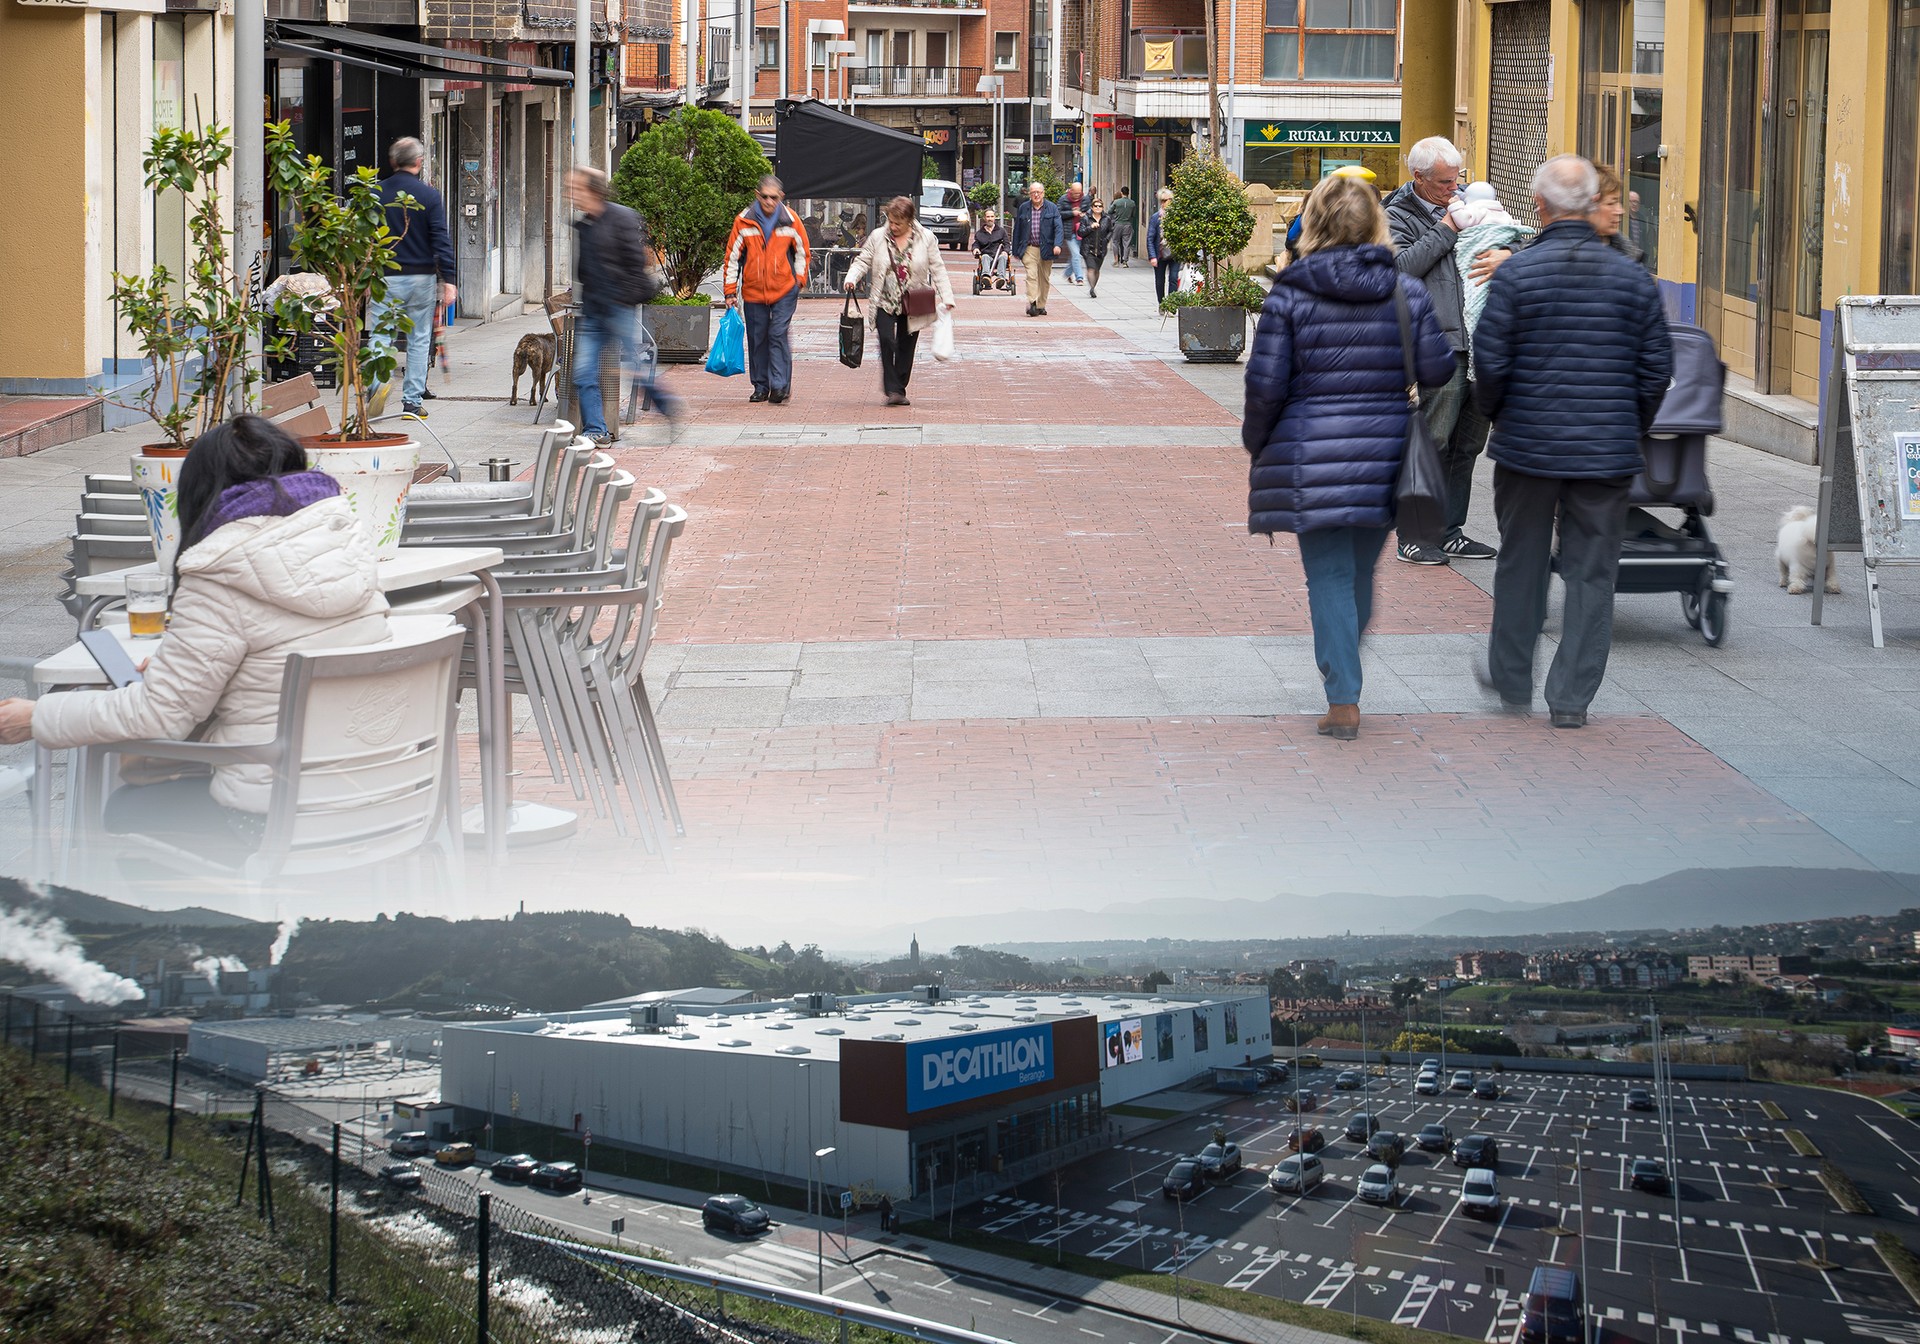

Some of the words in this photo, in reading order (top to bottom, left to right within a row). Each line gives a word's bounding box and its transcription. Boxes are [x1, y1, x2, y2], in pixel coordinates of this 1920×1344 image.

[1288, 130, 1335, 142] RURAL
[1339, 130, 1394, 142] KUTXA
[922, 1035, 1045, 1091] DECATHLON
[1019, 1069, 1046, 1083] Berango
